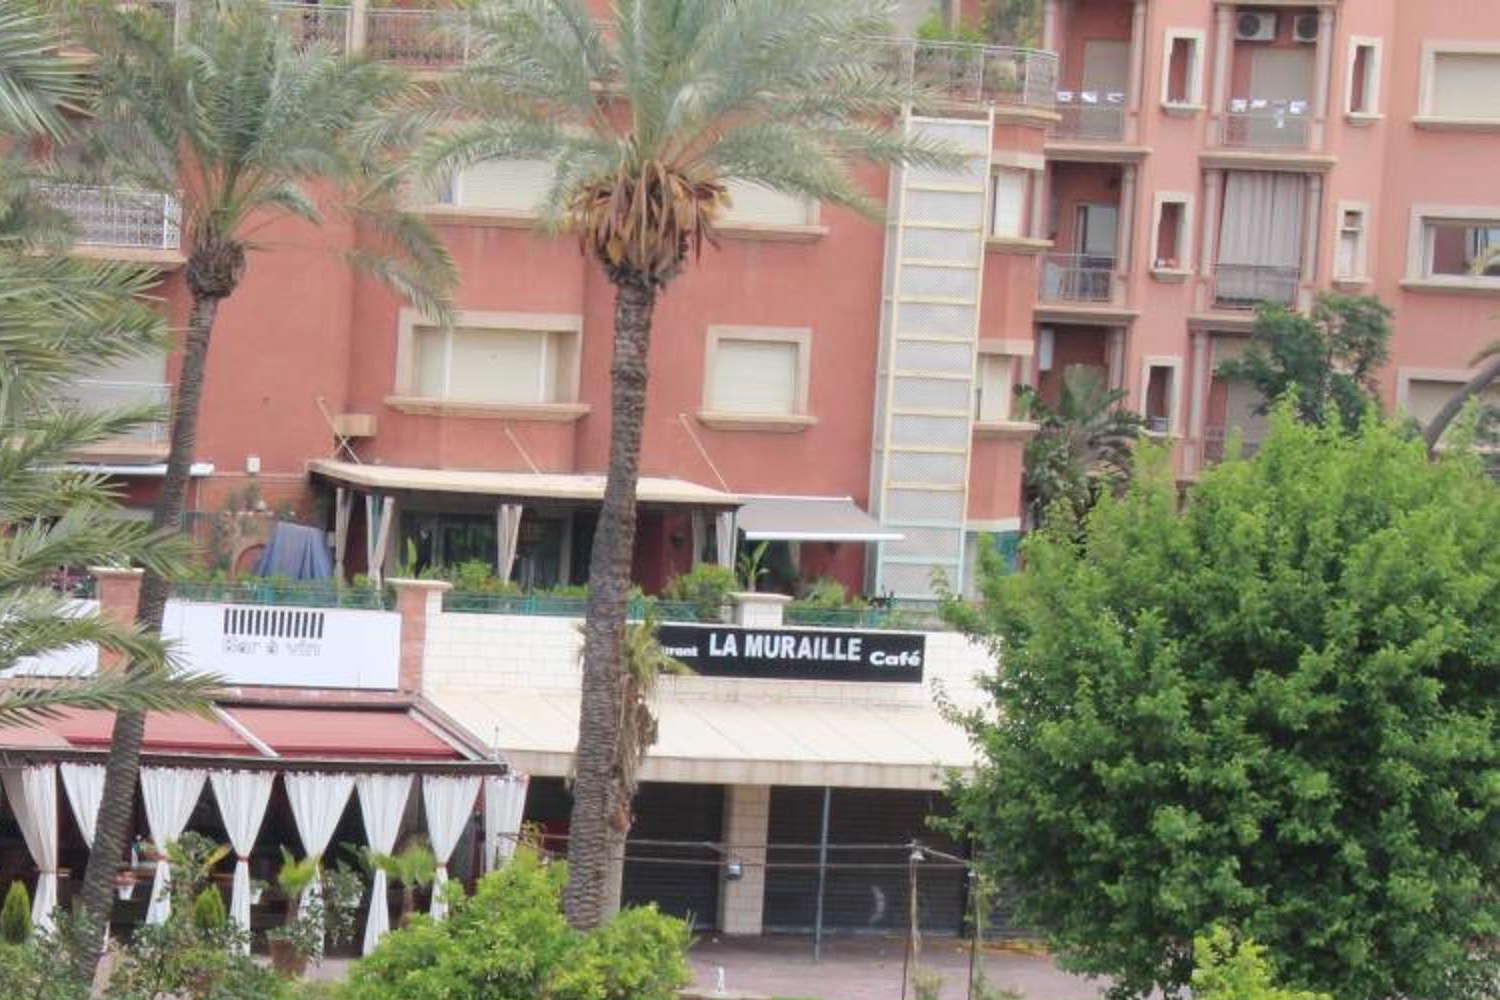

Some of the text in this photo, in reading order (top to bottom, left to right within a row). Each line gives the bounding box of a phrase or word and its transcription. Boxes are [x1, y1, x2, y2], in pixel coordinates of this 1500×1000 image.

[709, 633, 738, 657] LA
[745, 634, 863, 662] MURAILLE
[869, 650, 921, 667] Café
